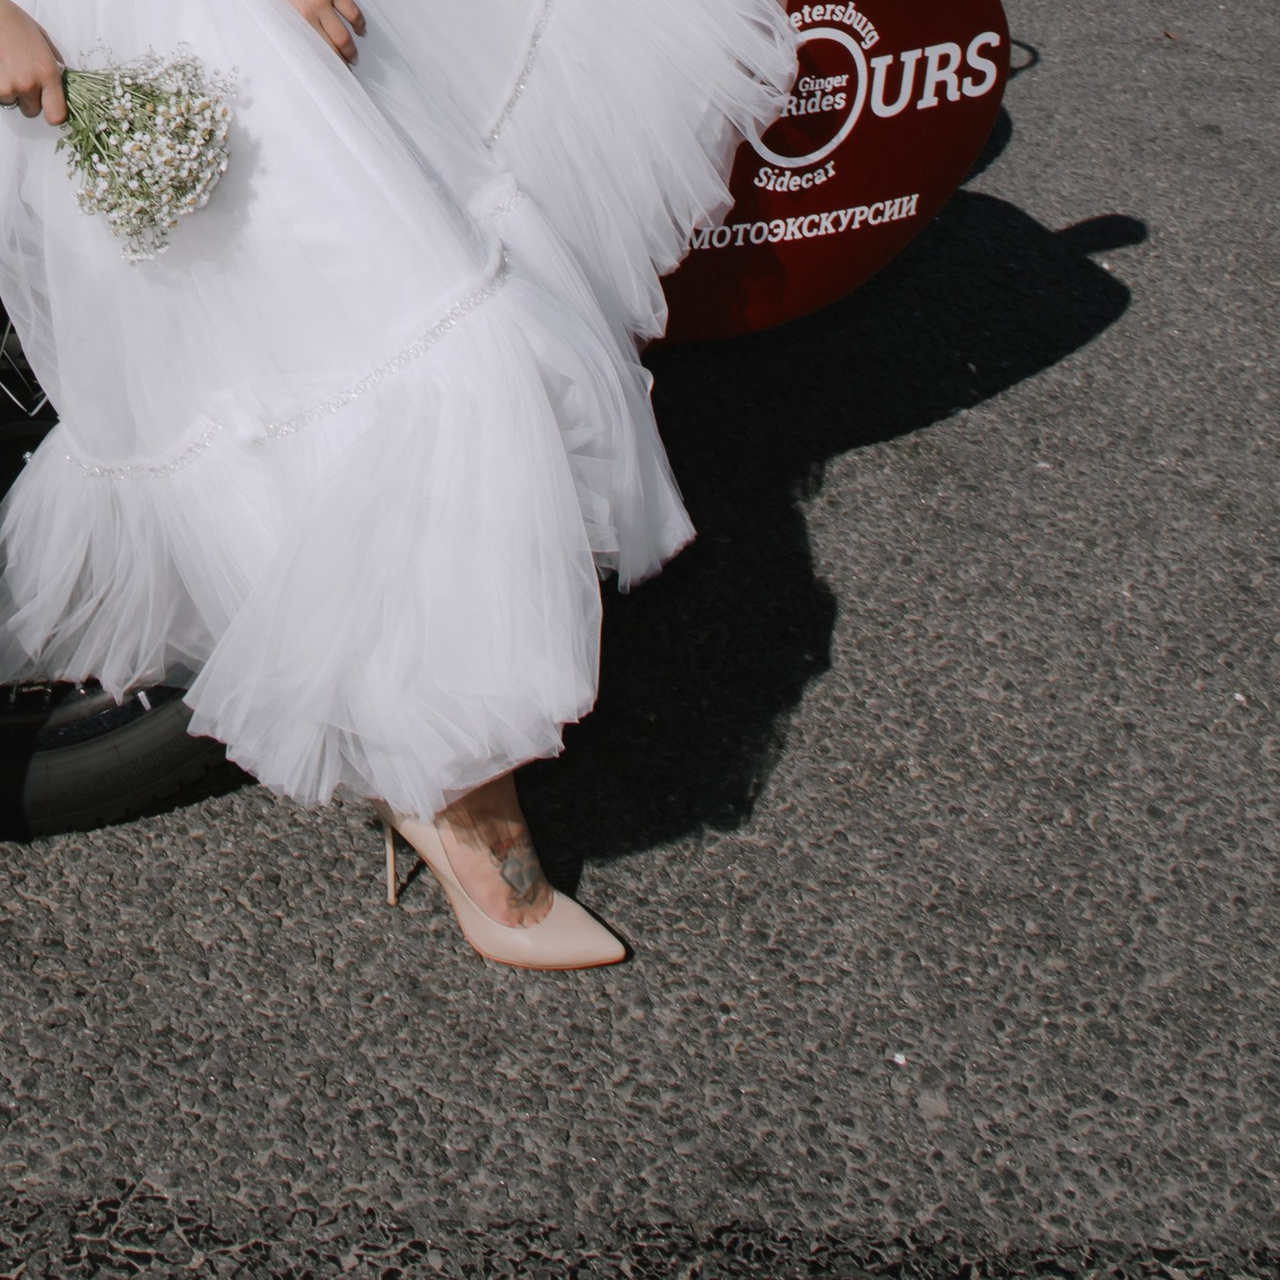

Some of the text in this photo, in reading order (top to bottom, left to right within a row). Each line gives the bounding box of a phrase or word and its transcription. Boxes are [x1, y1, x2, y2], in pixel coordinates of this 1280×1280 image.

[789, 0, 880, 50] etersburg
[798, 74, 850, 93] Ginger
[780, 90, 847, 117] Rides
[753, 160, 836, 192] Sidecar
[683, 193, 920, 250] МОТОЭКСКУРСИИ
